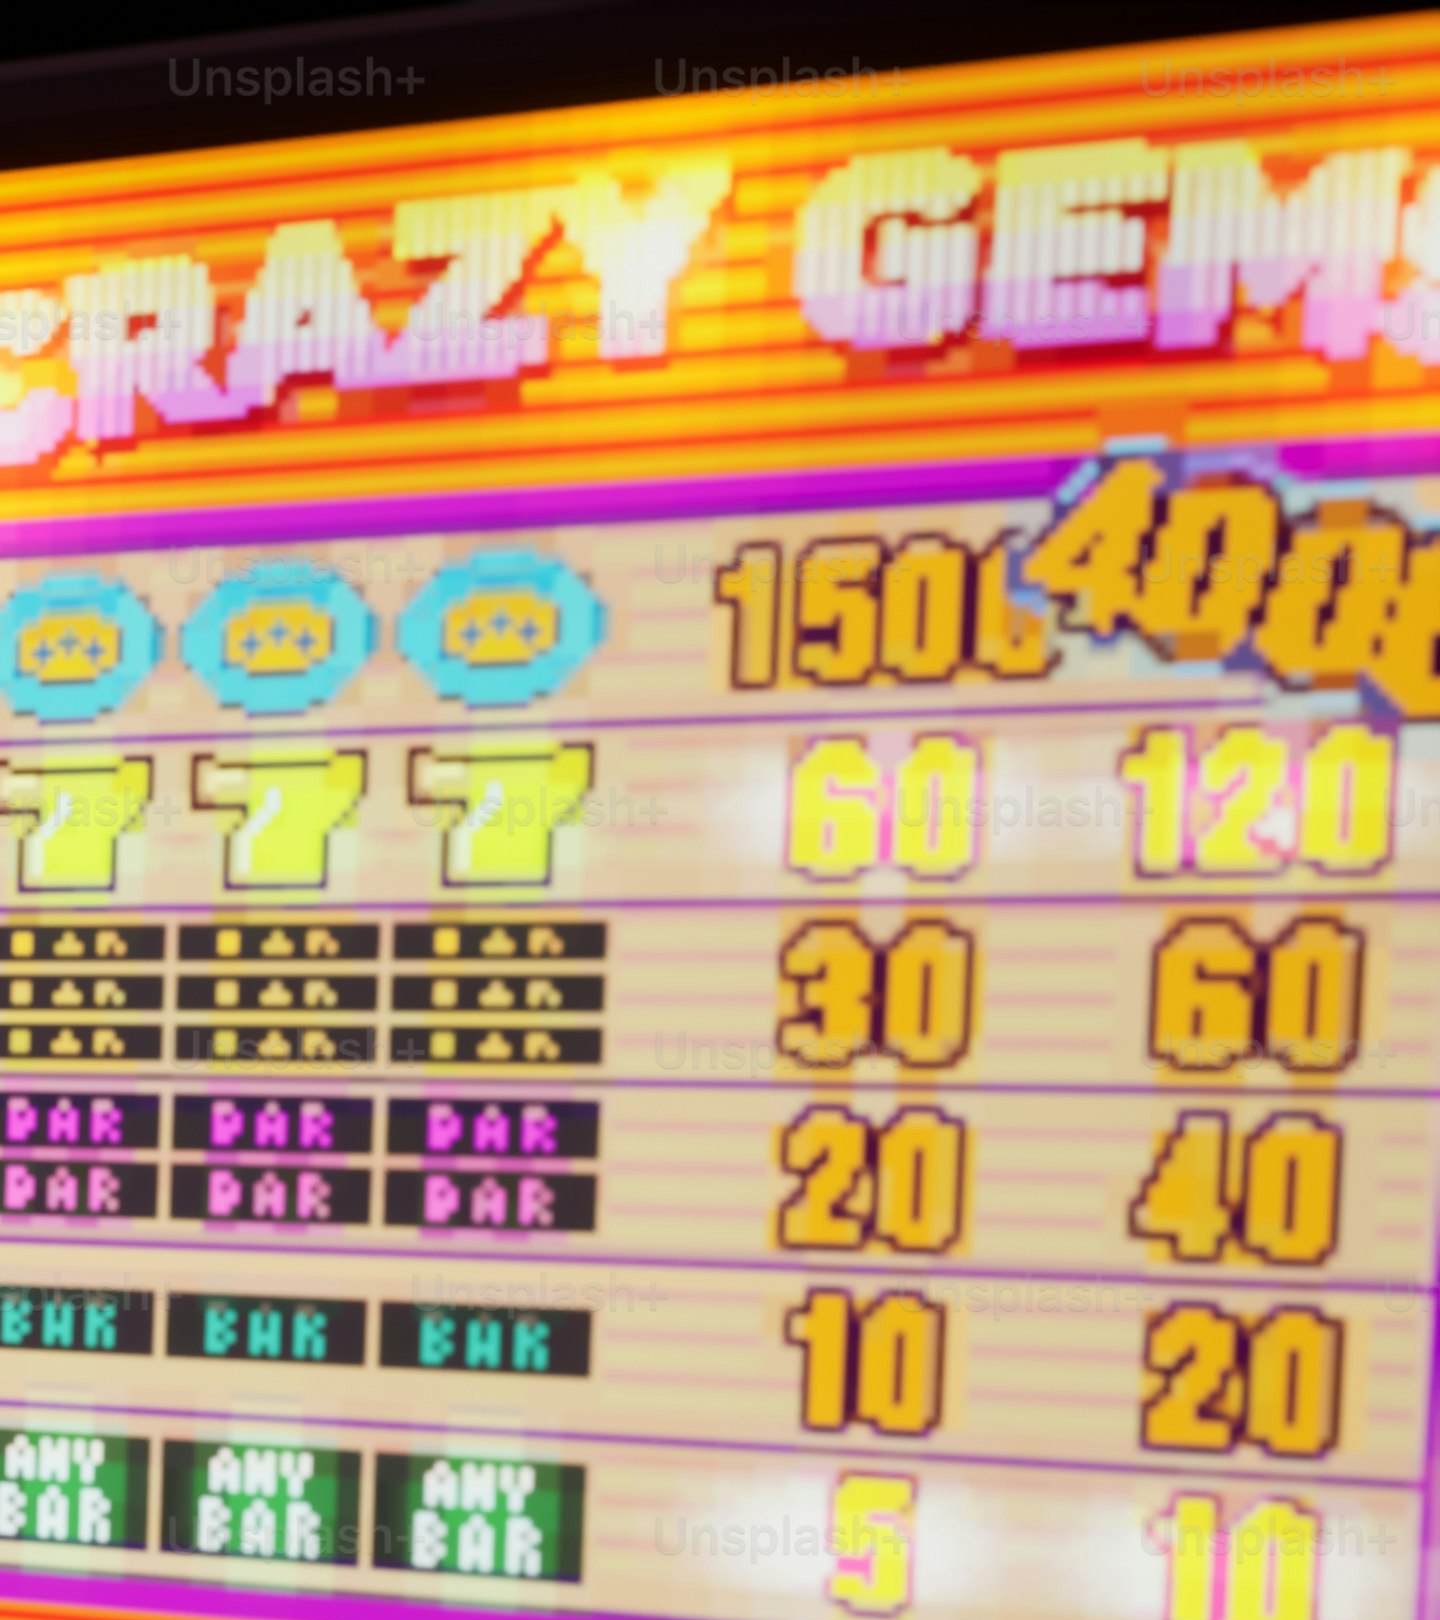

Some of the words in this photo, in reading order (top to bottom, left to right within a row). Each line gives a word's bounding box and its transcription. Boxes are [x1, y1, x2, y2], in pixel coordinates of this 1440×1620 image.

[796, 140, 1440, 358] GEM
[191, 747, 366, 892] 7
[407, 742, 595, 892] 7
[782, 739, 980, 882] 60
[1122, 725, 1396, 880] 120
[777, 917, 977, 1073] 30
[1148, 917, 1367, 1073] 60
[776, 1105, 975, 1253] 20
[1129, 1110, 1343, 1265] 40
[2, 1288, 119, 1353] BAR
[785, 1288, 946, 1436] 10
[1142, 1303, 1343, 1459] 20
[827, 1473, 914, 1617] 5
